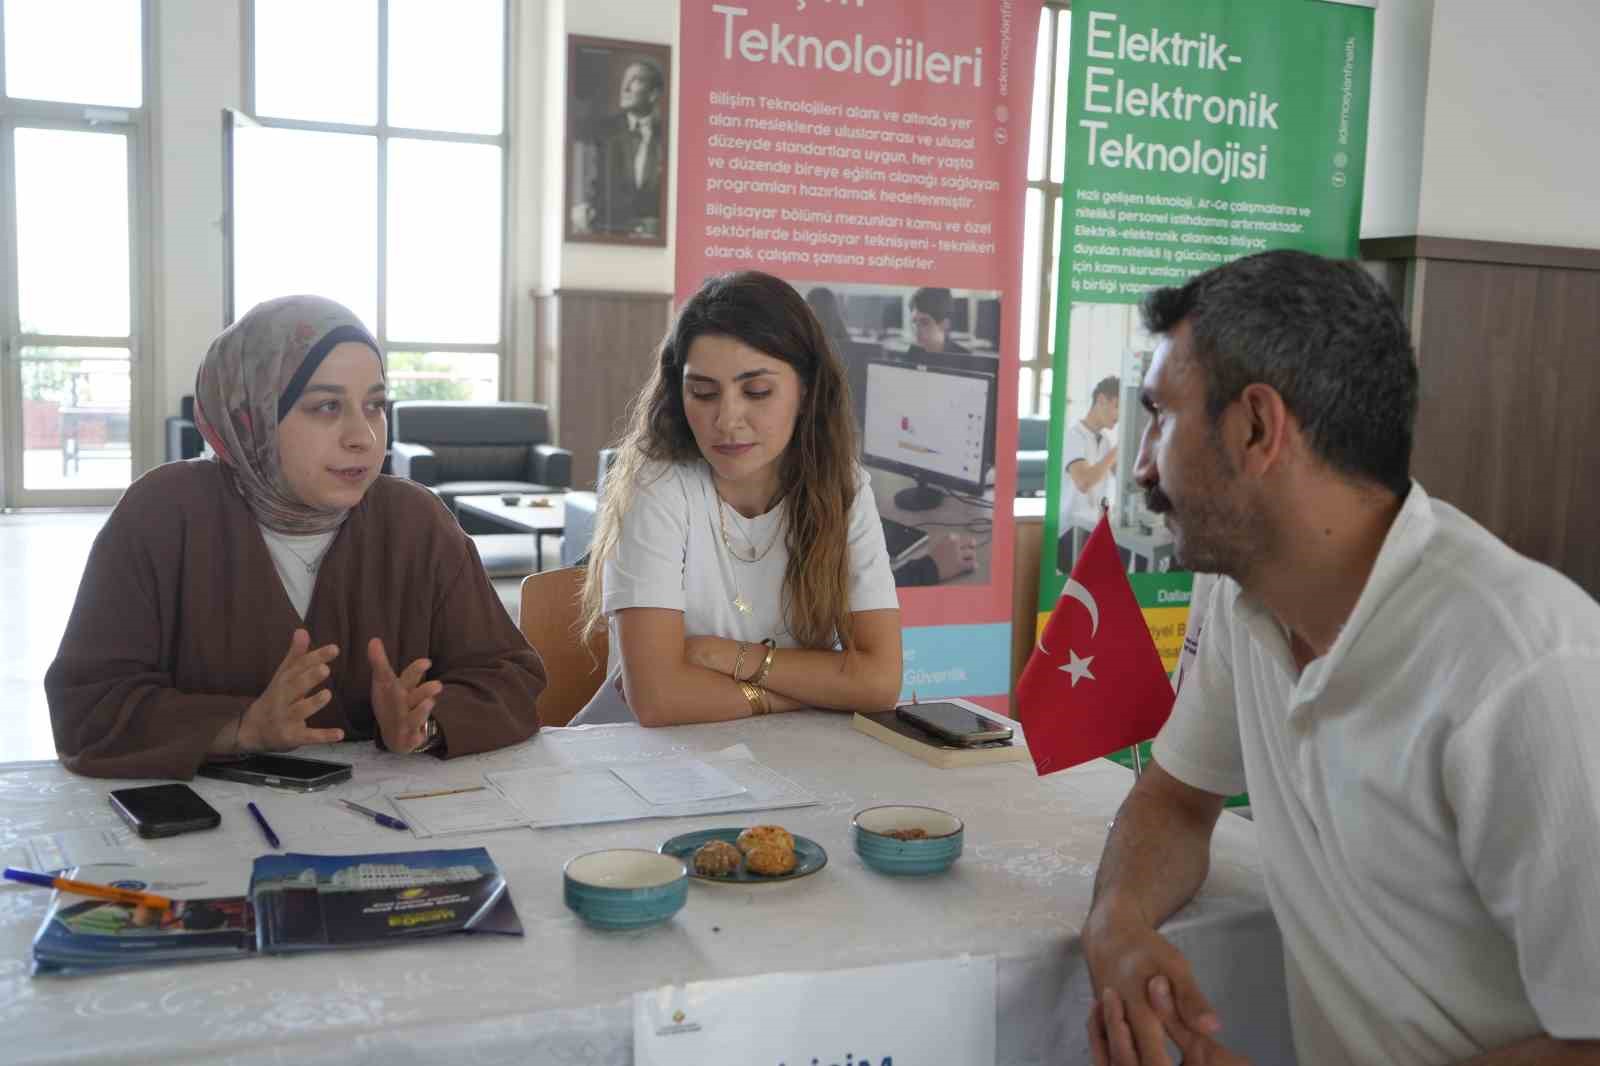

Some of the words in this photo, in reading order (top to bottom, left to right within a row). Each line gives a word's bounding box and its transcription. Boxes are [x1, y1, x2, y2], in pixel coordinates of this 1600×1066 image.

[712, 4, 983, 87] Teknolojileri
[1087, 10, 1242, 71] Elektrik-
[709, 91, 755, 109] Bilişim
[758, 96, 843, 116] Teknolojileri
[884, 111, 898, 122] ve
[950, 118, 973, 130] yer
[1084, 66, 1279, 129] Elektronik
[709, 113, 741, 127] alan
[744, 117, 832, 135] mesleklerde
[917, 135, 932, 147] ve
[707, 156, 725, 169] ve
[728, 156, 791, 174] düzende
[708, 134, 771, 152] düzeyde
[912, 152, 934, 165] her
[1079, 119, 1268, 184] Teknolojisi
[705, 203, 777, 220] Bilgisayar
[906, 217, 941, 231] kamu
[944, 222, 960, 233] ve
[704, 244, 753, 259] olarak
[705, 224, 789, 241] sektörlerde
[793, 229, 859, 247] bilgisayar
